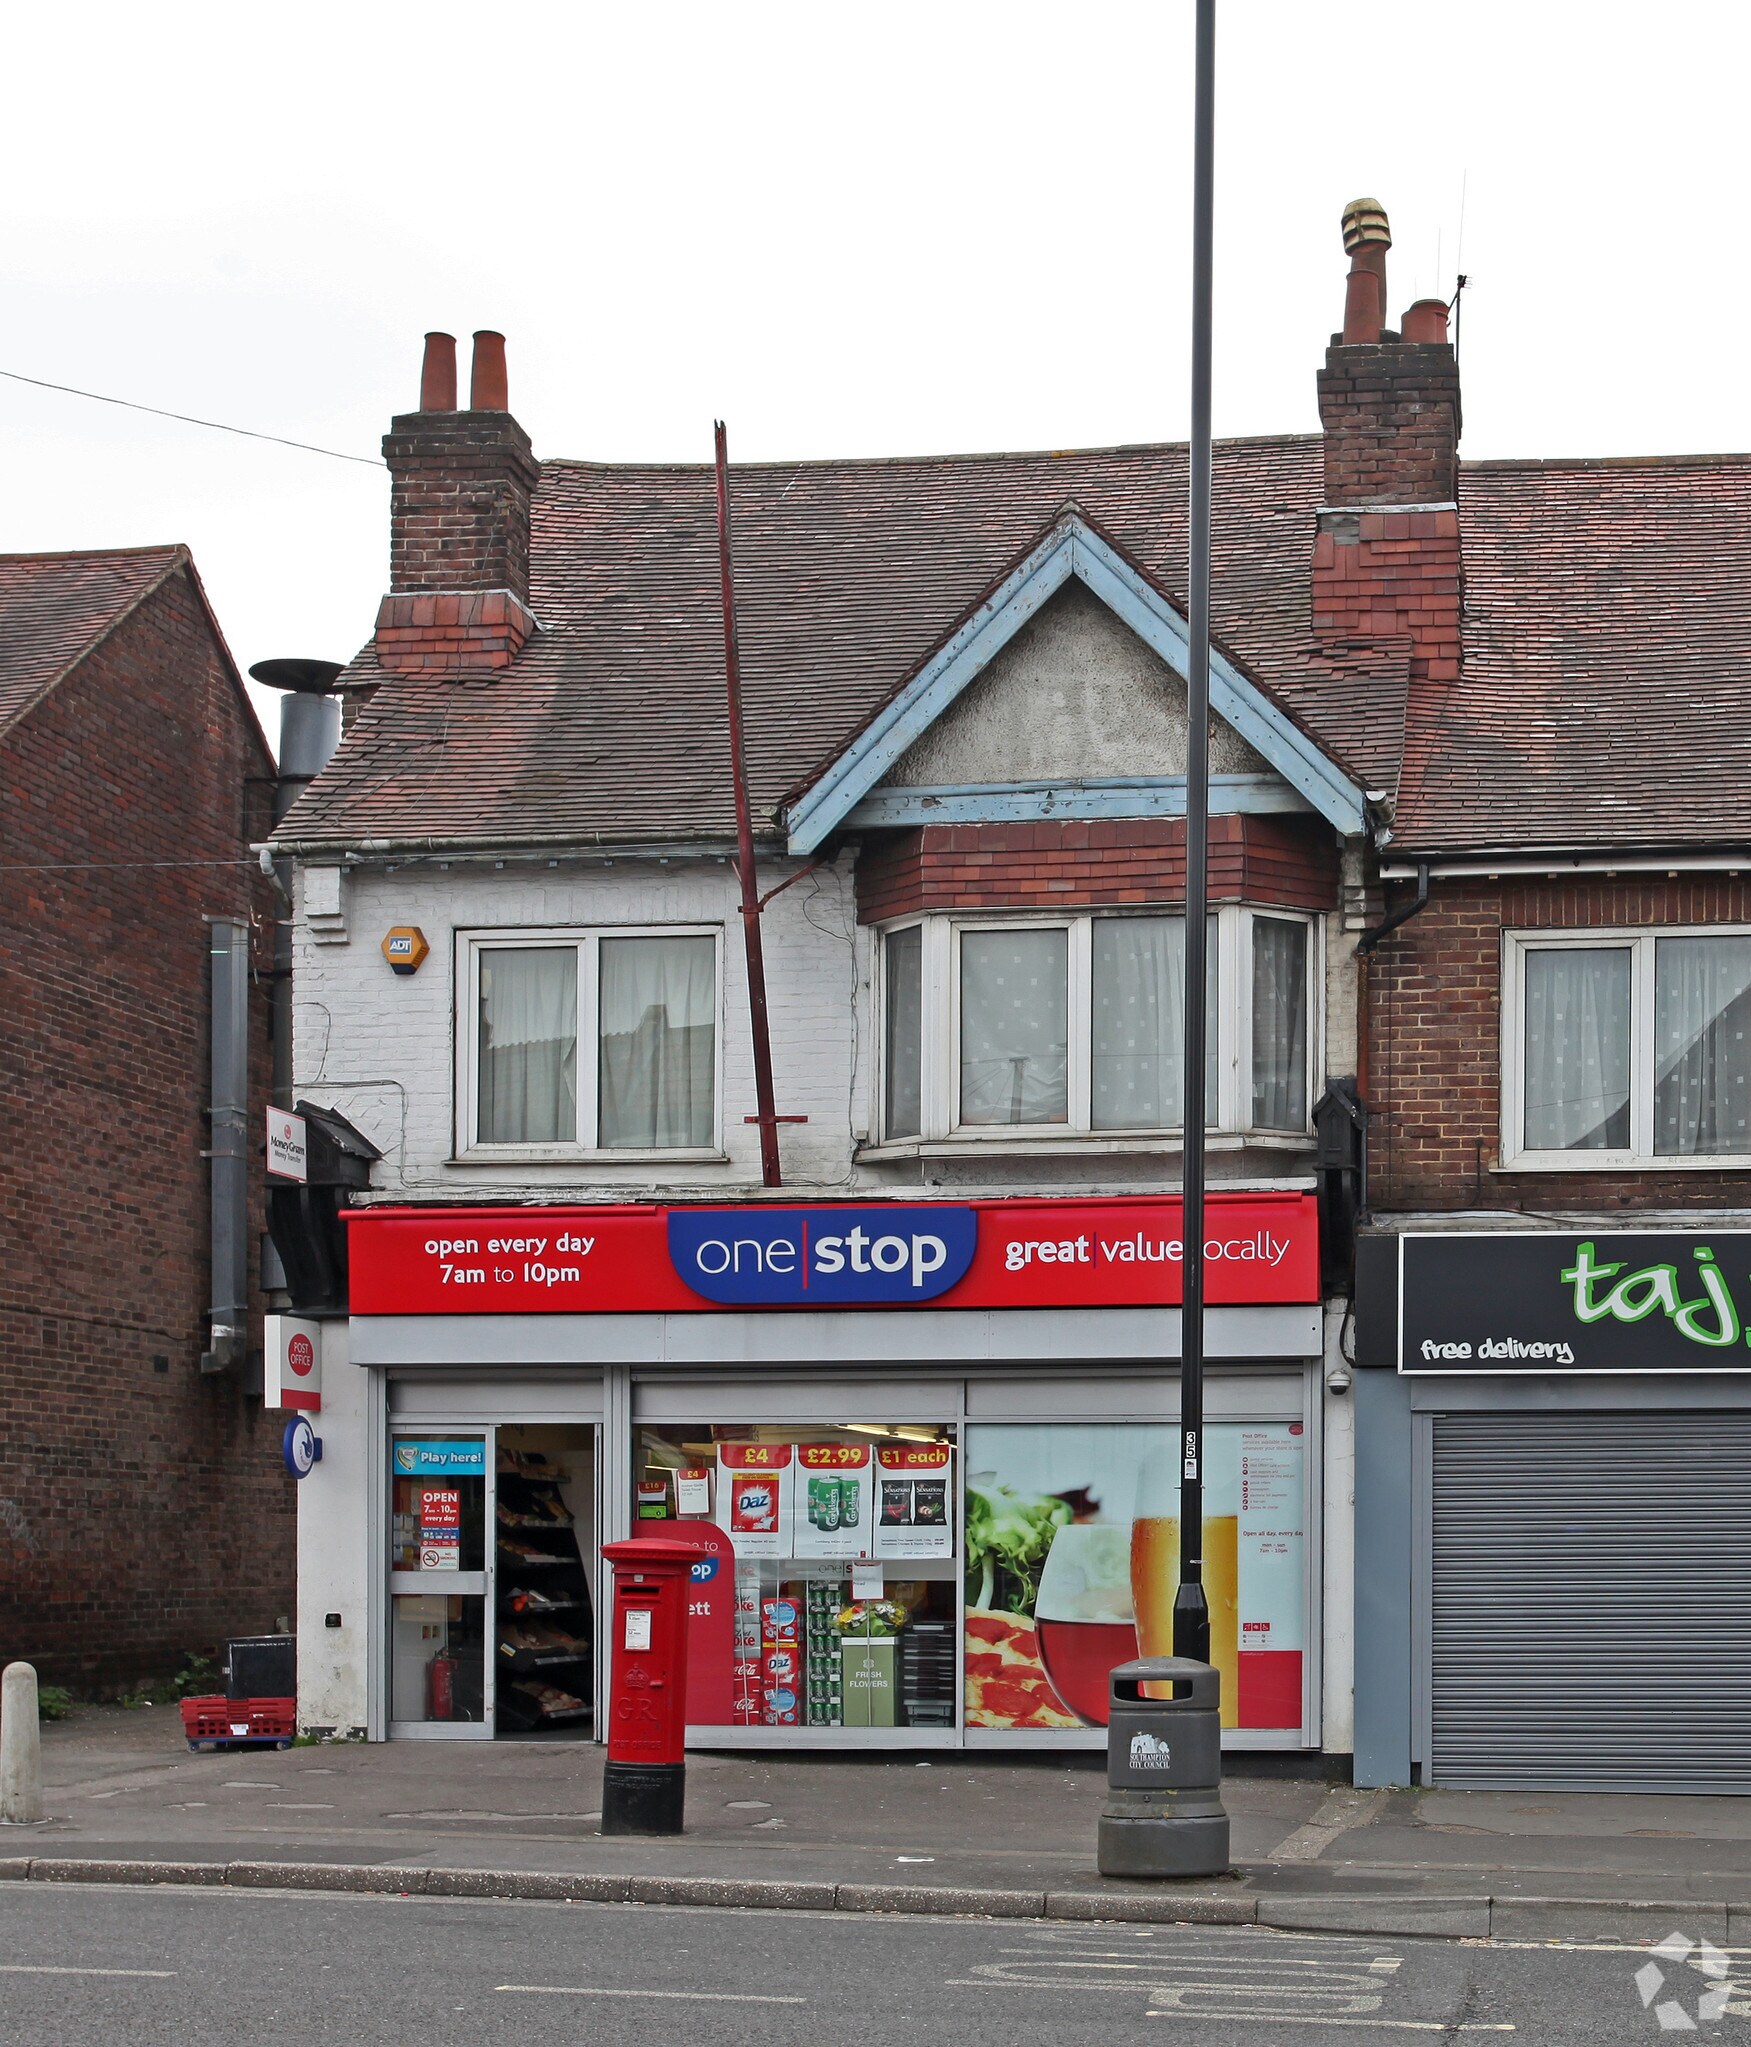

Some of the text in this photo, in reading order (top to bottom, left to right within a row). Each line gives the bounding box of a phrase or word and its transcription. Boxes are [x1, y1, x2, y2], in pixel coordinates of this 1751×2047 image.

[390, 940, 410, 951] ADT
[271, 1135, 305, 1155] MoneyGram
[424, 1232, 595, 1259] open every day
[1005, 1230, 1291, 1271] great value ocally
[696, 1225, 948, 1287] one stop
[439, 1262, 580, 1287] 7am to 10pm
[1561, 1241, 1740, 1347] taj
[294, 1342, 308, 1354] POST
[1420, 1336, 1575, 1365] free delivery
[290, 1353, 311, 1366] OFFICE
[420, 1452, 482, 1465] Play here!
[745, 1447, 769, 1463] £4
[807, 1447, 863, 1464] £2.99
[882, 1448, 946, 1464] £1 each
[687, 1470, 699, 1478] £4
[423, 1492, 458, 1503] OPEN
[739, 1494, 768, 1511] Daz
[443, 1514, 456, 1523] day
[704, 1540, 719, 1552] to
[691, 1564, 712, 1580] op
[734, 1602, 755, 1612] oke
[734, 1636, 756, 1647] oke
[768, 1658, 790, 1669] Daz
[849, 1680, 888, 1688] FLOWERS
[618, 1697, 657, 1720] GR
